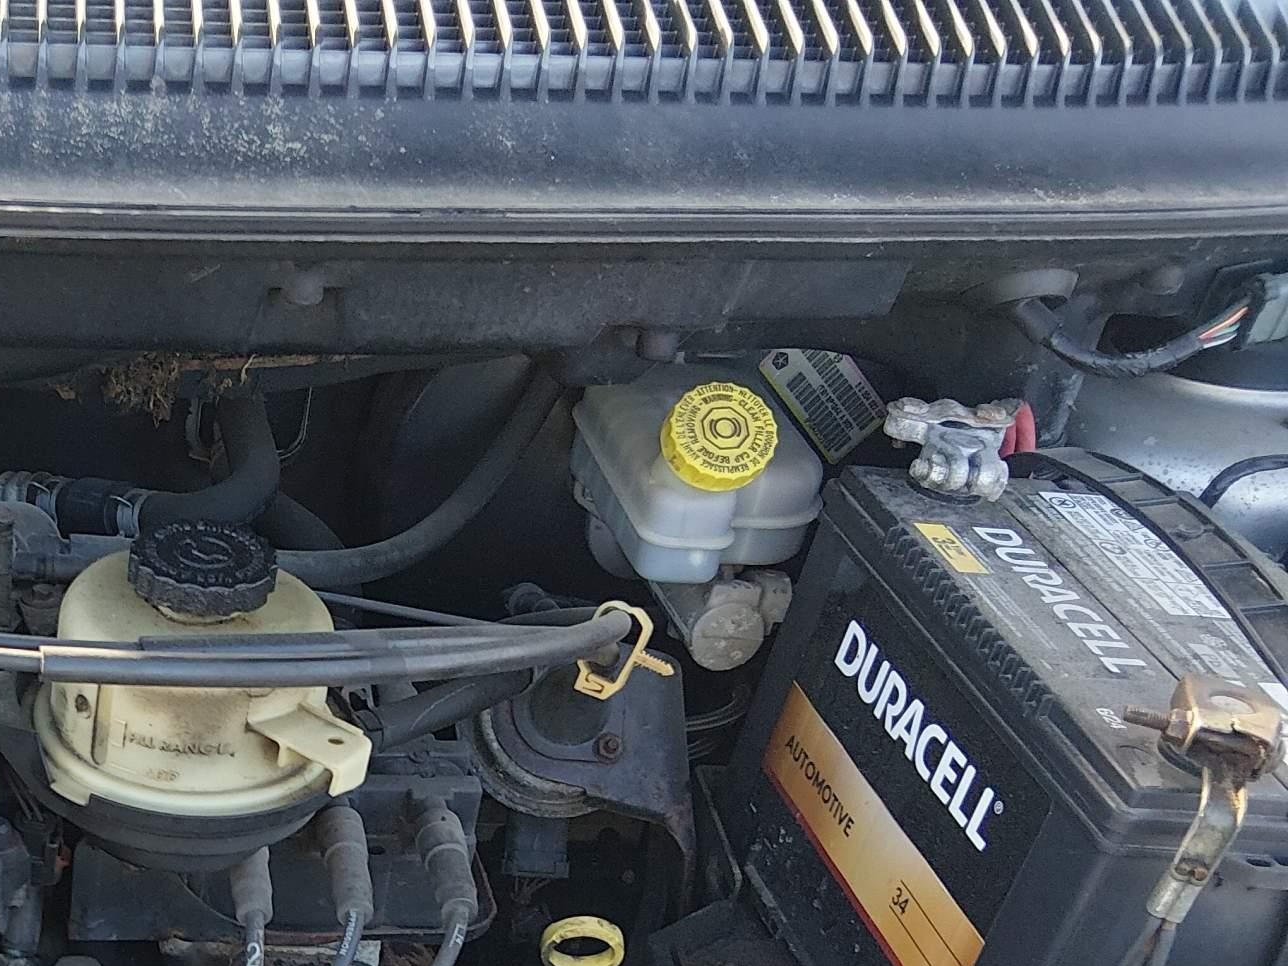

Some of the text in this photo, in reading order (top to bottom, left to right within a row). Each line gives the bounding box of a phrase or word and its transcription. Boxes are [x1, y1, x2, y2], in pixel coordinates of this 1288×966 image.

[972, 526, 1148, 674] DURACELL
[785, 735, 855, 838] AUTOMOTIVE
[834, 619, 995, 852] DURACELL
[890, 887, 911, 915] 34
